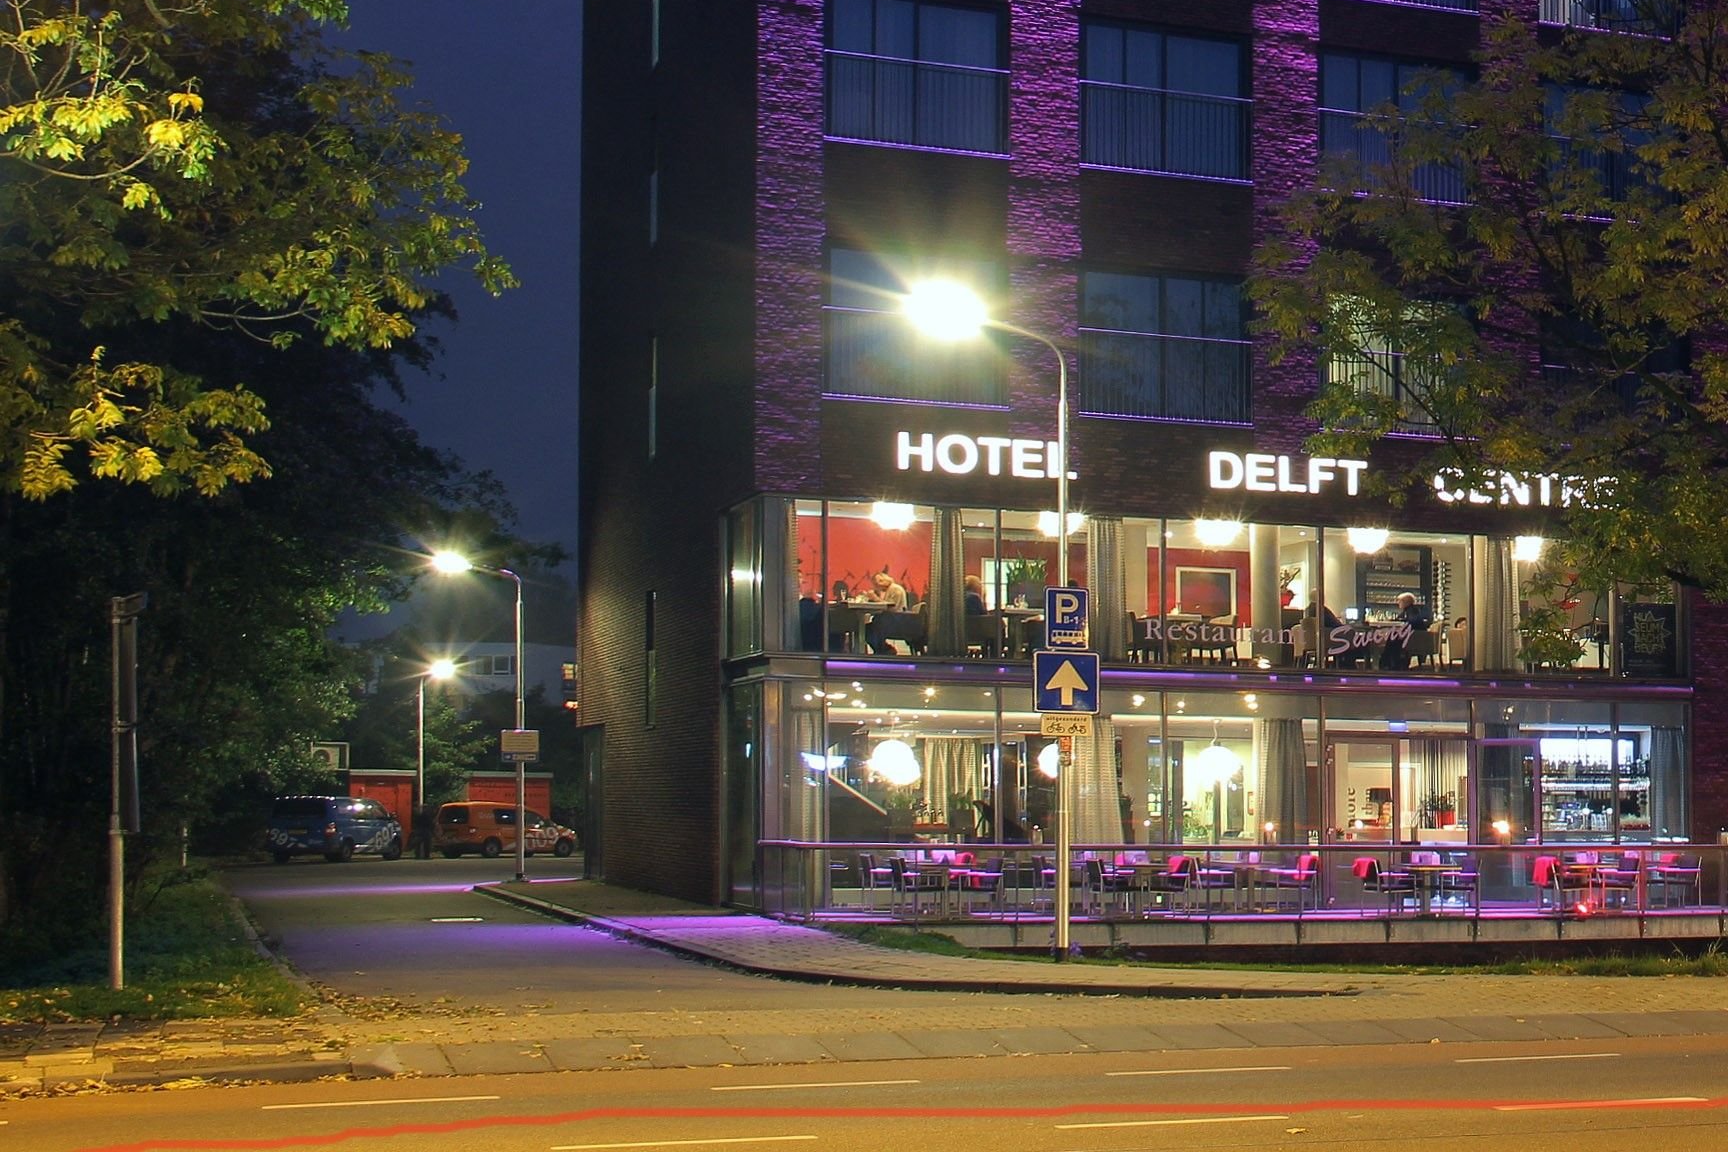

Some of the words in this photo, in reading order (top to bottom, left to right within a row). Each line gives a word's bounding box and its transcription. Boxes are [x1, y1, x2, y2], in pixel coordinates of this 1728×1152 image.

[897, 431, 1078, 481] HOTEL
[1209, 451, 1369, 496] DELFT
[1433, 466, 1620, 511] CENTRE
[1055, 592, 1079, 624] P
[1144, 618, 1307, 645] Restaurant
